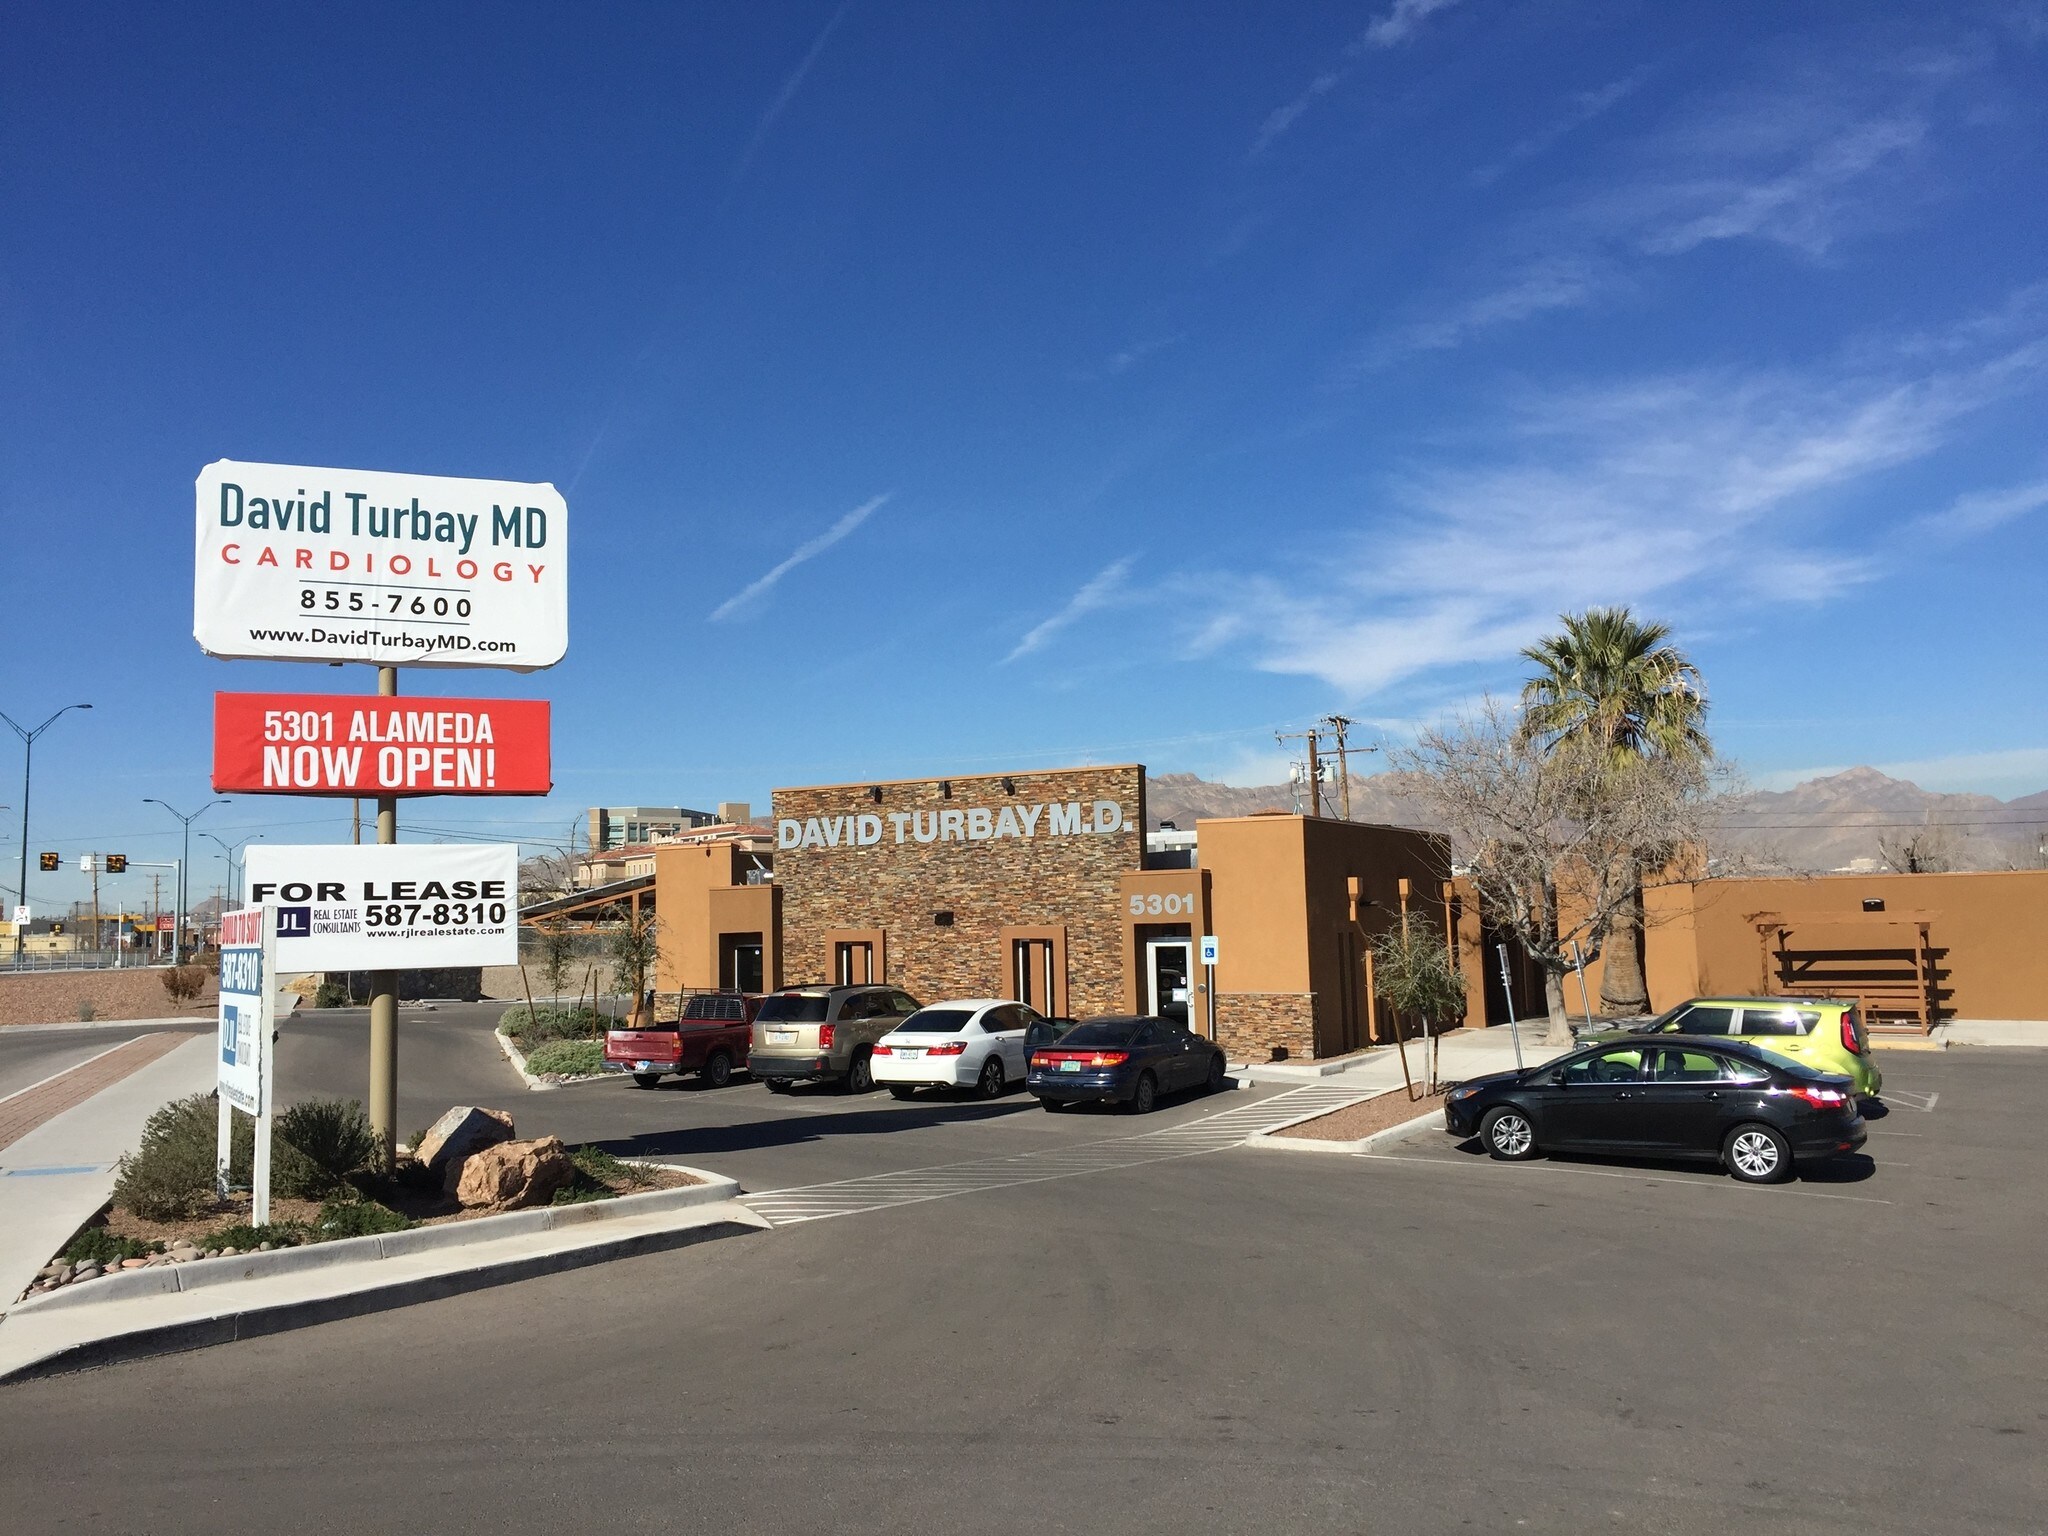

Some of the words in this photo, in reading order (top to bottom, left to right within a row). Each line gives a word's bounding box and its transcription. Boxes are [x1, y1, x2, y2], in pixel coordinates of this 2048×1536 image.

[219, 482, 331, 534] David
[344, 492, 478, 555] Turbay
[492, 504, 547, 549] MD
[221, 543, 546, 583] CARDIOLOGY
[300, 589, 472, 618] 855-7600
[249, 628, 516, 653] www.DavidTurbayMD.com
[264, 710, 334, 742] 5301
[348, 711, 494, 744] ALAMEDA
[263, 746, 363, 787] NOW
[377, 747, 496, 788] OPEN!
[778, 814, 882, 850] DAVID
[889, 804, 1044, 844] TURBAY
[1049, 800, 1133, 837] M.D.
[252, 883, 347, 902] FOR
[363, 881, 505, 901] LEASE
[1129, 893, 1195, 916] 5301
[222, 916, 237, 945] BUILD
[238, 914, 246, 944] TO
[246, 911, 262, 944] SUIT
[313, 909, 331, 920] REAL
[333, 909, 358, 920] ESTATE
[313, 921, 361, 934] CONSULTANTS
[365, 903, 506, 926] 587-8310
[366, 928, 505, 939] www.rjlrealestate.com
[222, 952, 258, 992] 587-8310
